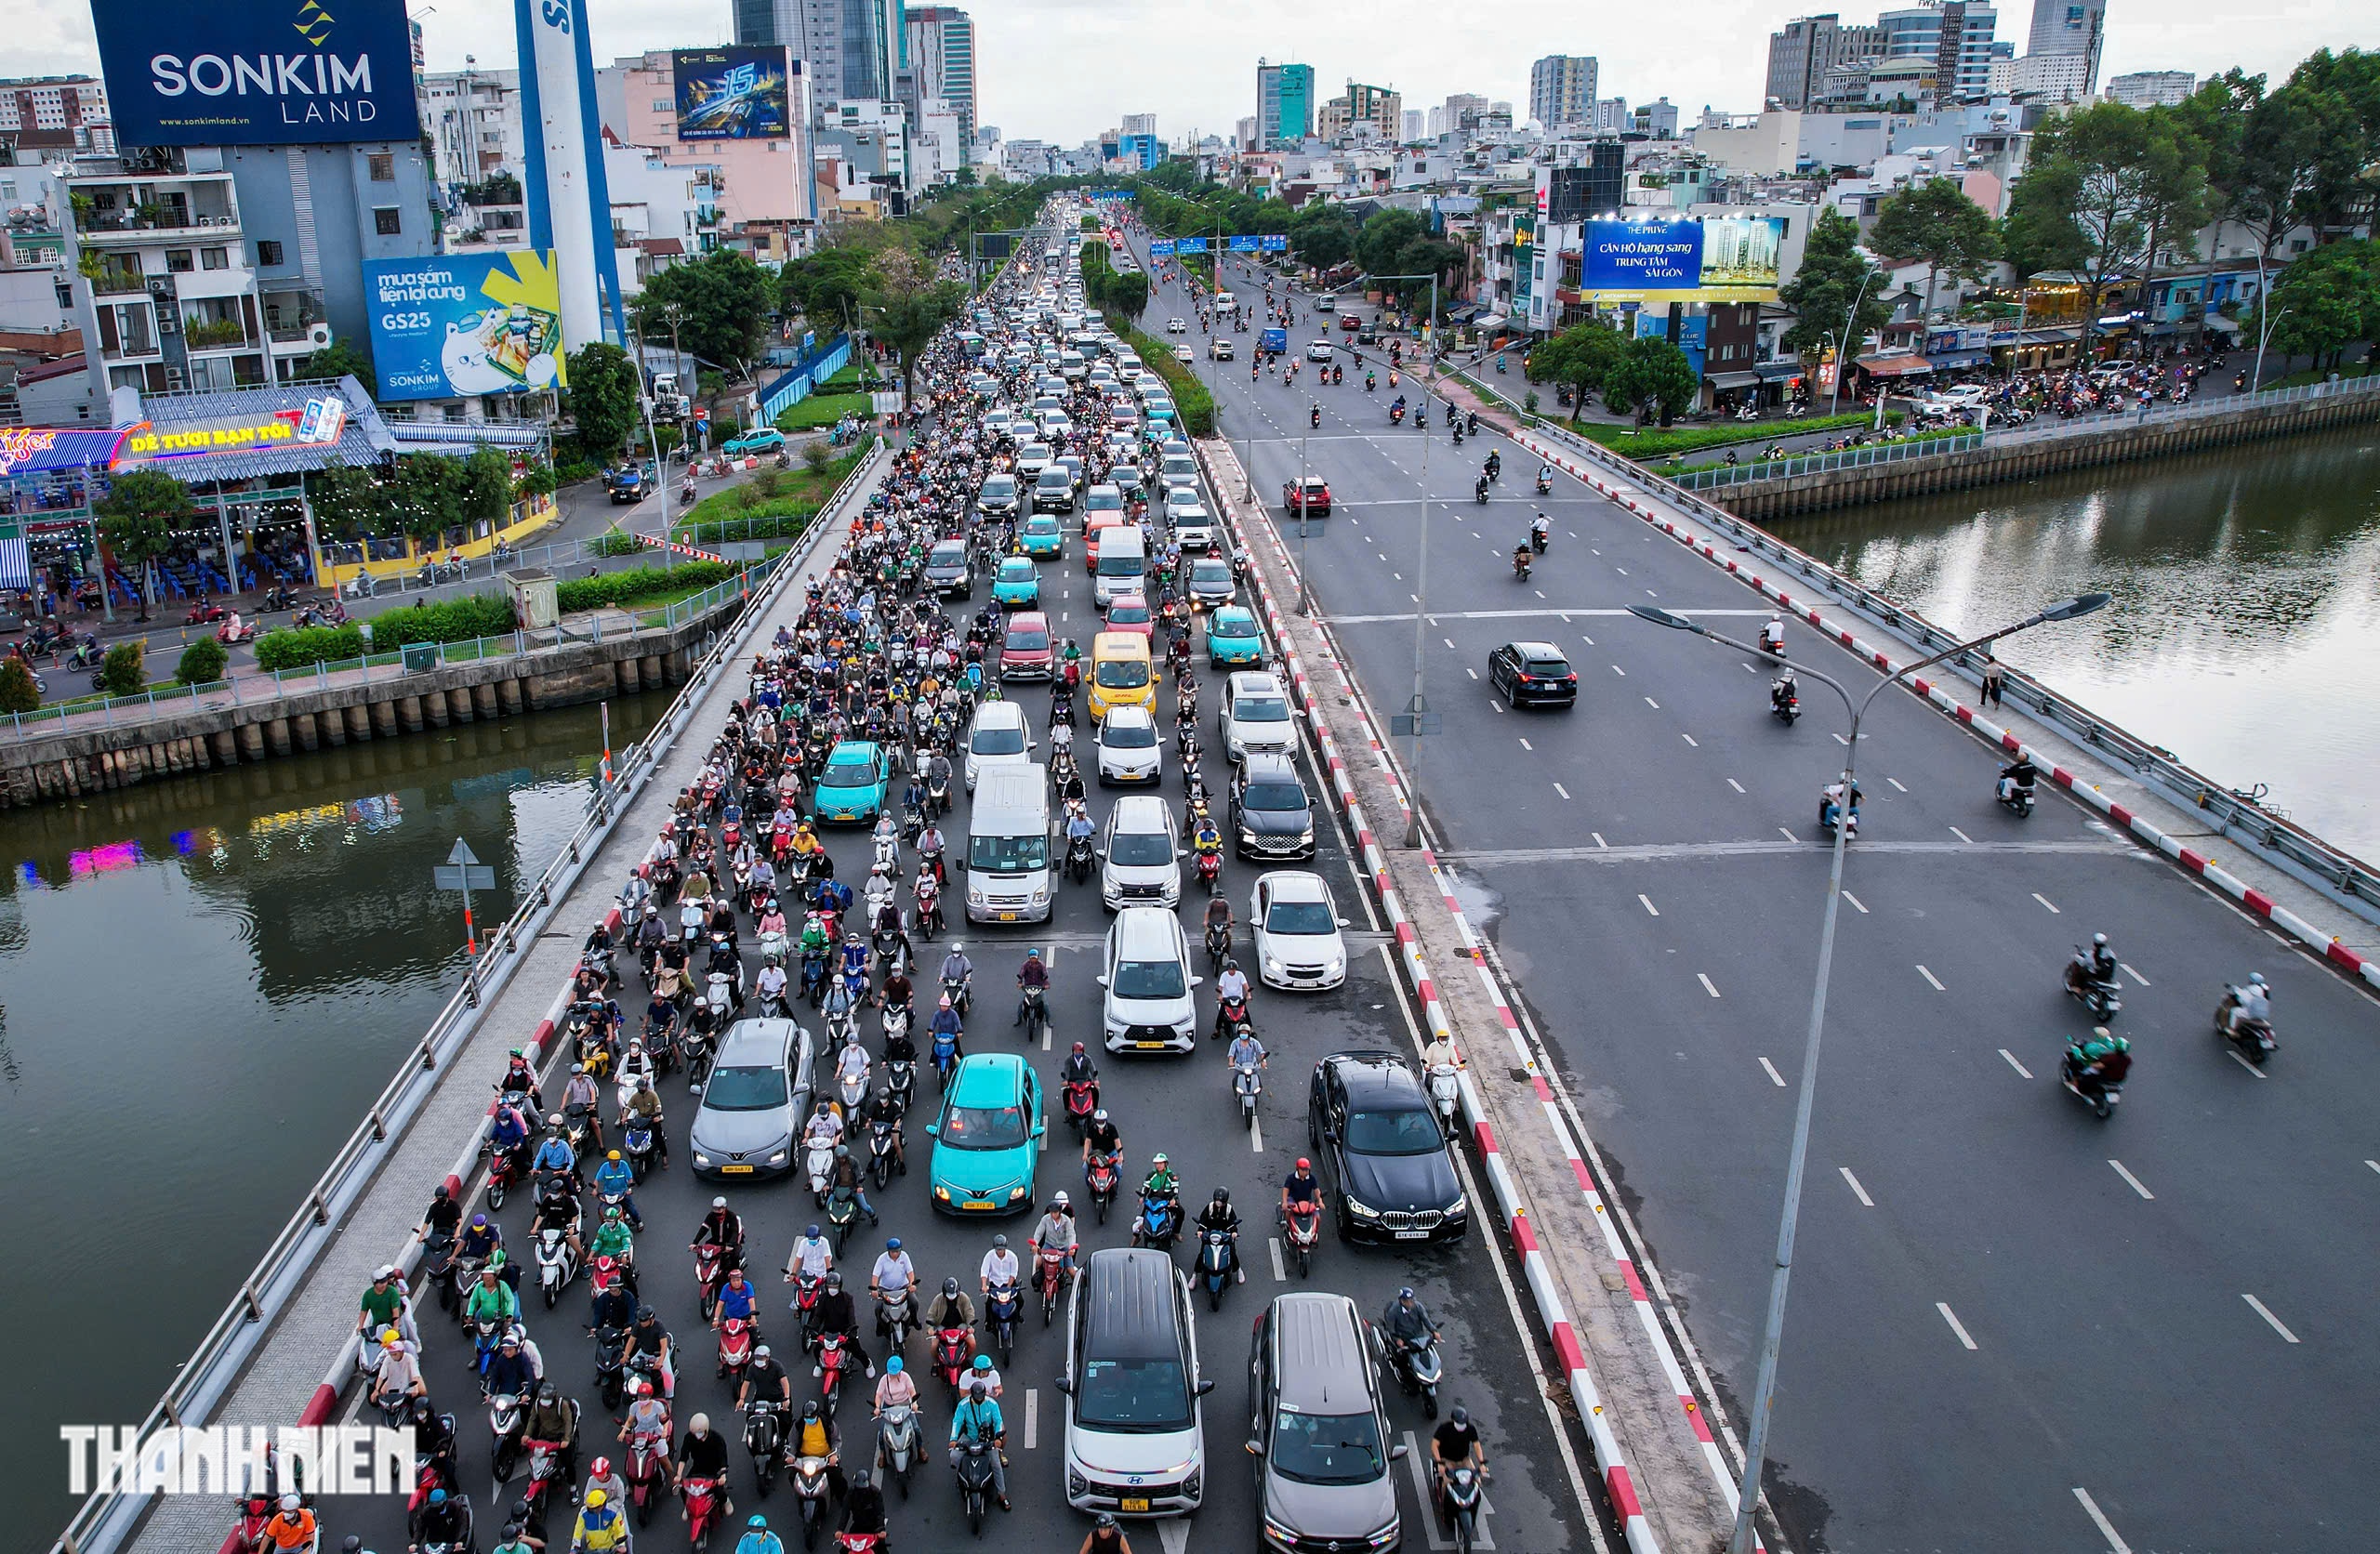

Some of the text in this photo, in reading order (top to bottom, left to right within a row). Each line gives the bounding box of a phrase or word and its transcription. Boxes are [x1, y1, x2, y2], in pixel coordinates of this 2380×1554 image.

[151, 54, 373, 97] SONKIM
[723, 62, 755, 100] 15
[160, 117, 250, 125] www.sonkimland.vn
[281, 100, 377, 124] LAND
[1627, 226, 1642, 234] THE
[1599, 242, 1693, 255] CĂN HỘ hạng sang
[1614, 257, 1668, 267] TRUNG TÂM
[378, 265, 452, 285] mua sắm
[379, 282, 465, 308] tiện lợi cùng
[382, 311, 431, 330] GS25
[389, 374, 440, 388] SONKIM
[0, 428, 56, 461] iger
[130, 434, 160, 453] DÊ
[212, 428, 255, 446] BẠN
[258, 422, 292, 441] TÔI
